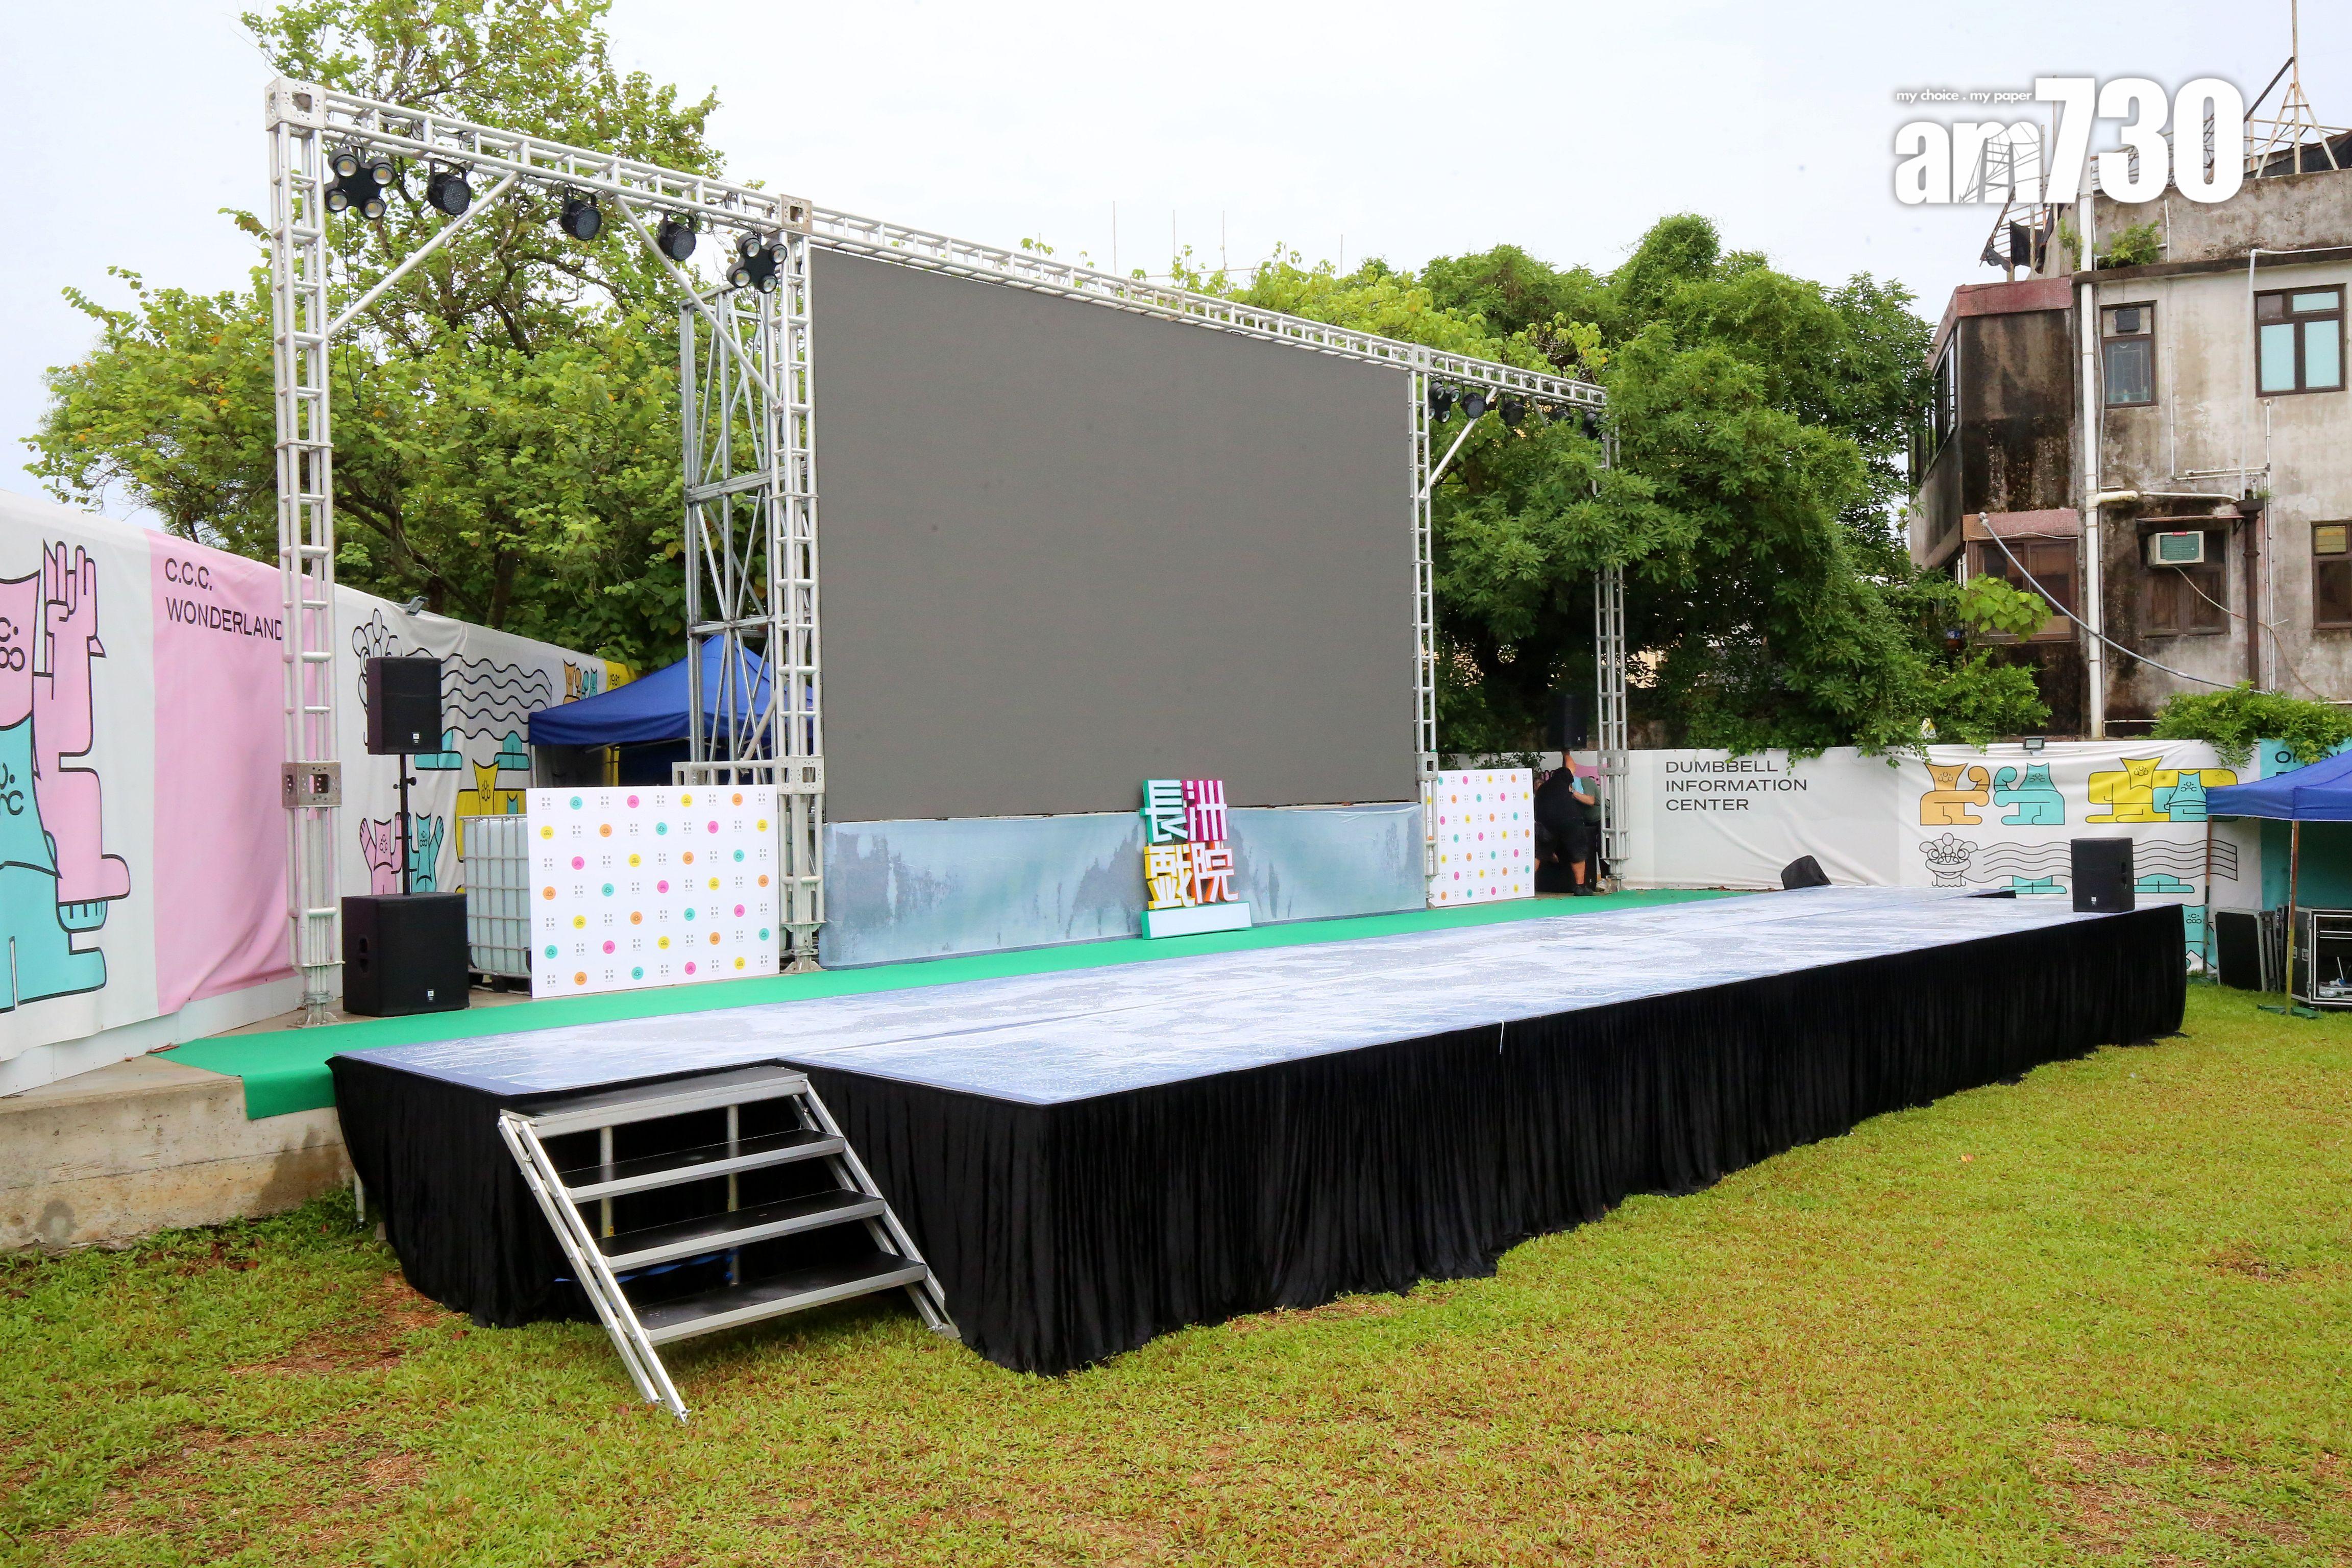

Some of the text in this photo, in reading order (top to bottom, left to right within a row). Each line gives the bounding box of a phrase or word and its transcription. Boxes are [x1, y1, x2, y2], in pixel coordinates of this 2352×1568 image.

[165, 558, 212, 591] C.C.C.
[165, 596, 282, 641] WONDERLAND
[1665, 760, 1778, 773] DUMBBELL
[1665, 779, 1807, 792] INFORMATION
[1140, 778, 1228, 843] 長洲
[1665, 798, 1749, 811] CENTER
